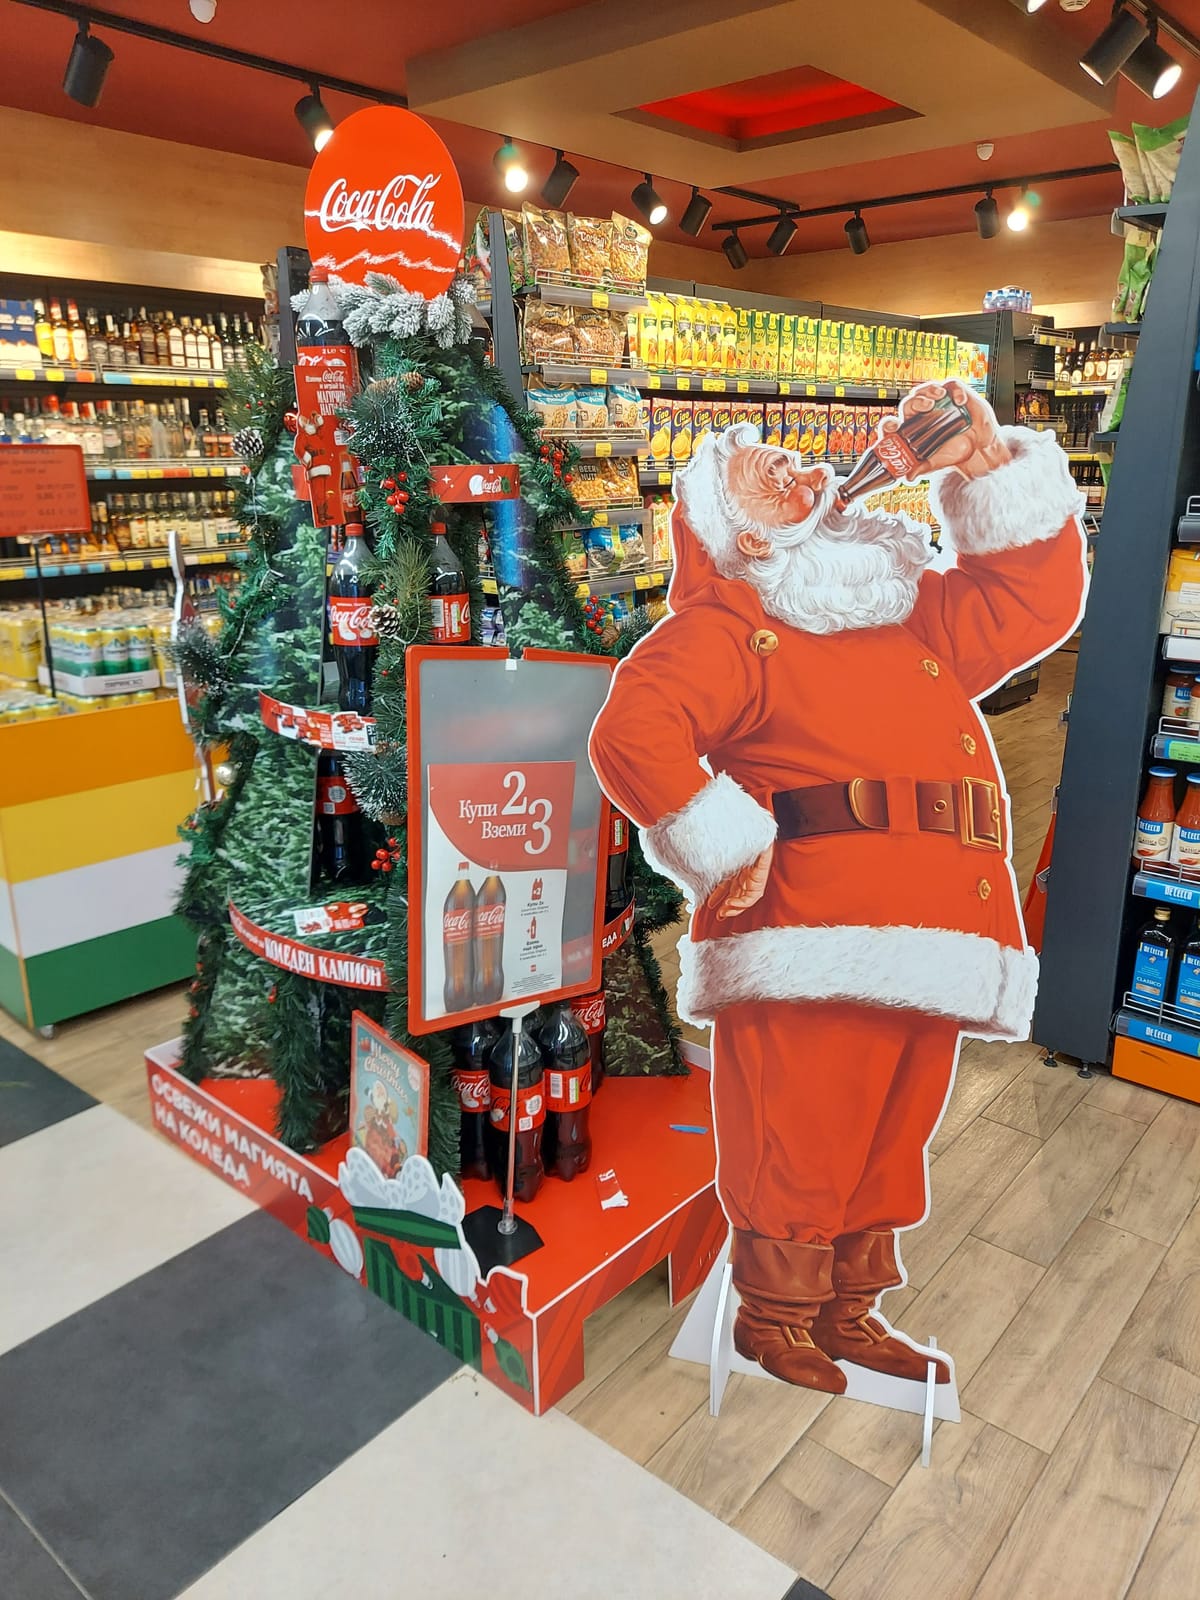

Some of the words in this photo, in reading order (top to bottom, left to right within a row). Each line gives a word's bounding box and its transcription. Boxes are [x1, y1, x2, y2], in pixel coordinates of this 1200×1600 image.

[319, 173, 442, 233] Coca-Cola
[459, 799, 498, 824] Купи
[501, 771, 527, 816] 2
[481, 820, 526, 840] Вземи
[524, 798, 553, 855] 3
[263, 937, 316, 974] КОЛЕДЕН
[318, 956, 382, 987] КАМИОН
[151, 1073, 222, 1140] ОСВЕЖИ
[223, 1124, 314, 1203] МАГИЯТА
[155, 1101, 178, 1135] НА
[179, 1119, 251, 1190] КОЛЕДА
